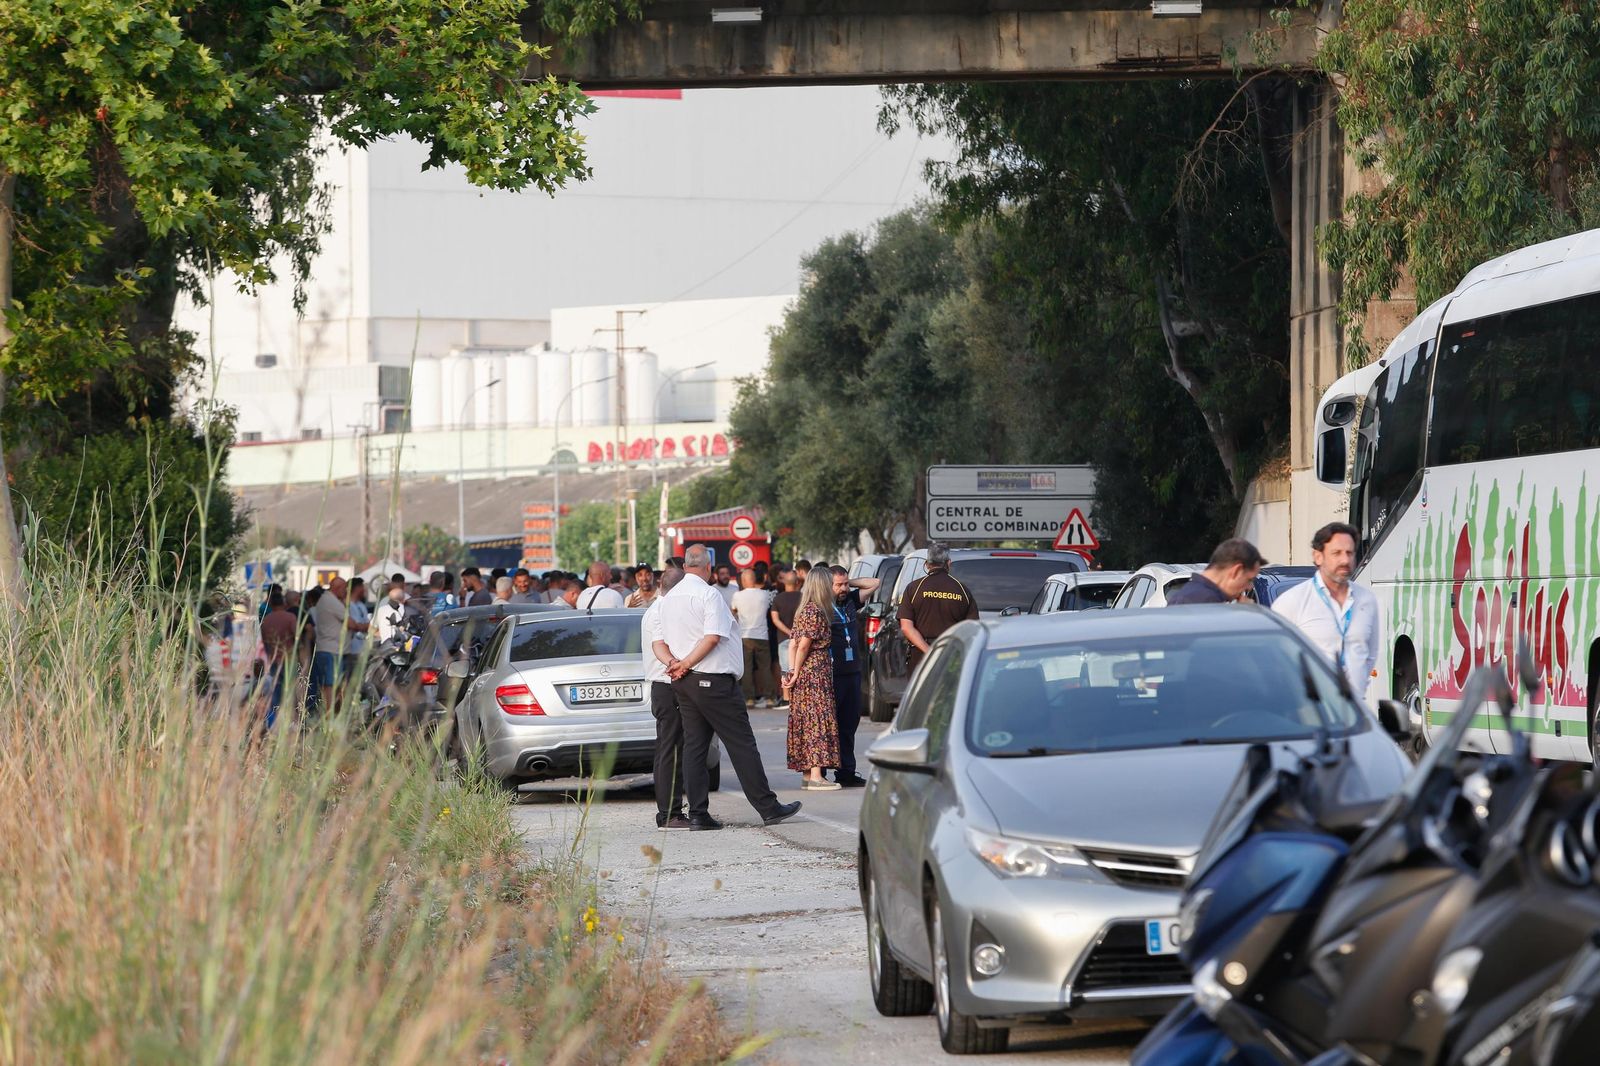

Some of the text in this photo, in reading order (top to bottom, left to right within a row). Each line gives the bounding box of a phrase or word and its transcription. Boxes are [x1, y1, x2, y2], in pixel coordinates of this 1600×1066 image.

[936, 506, 1023, 517] CENTRAL DE
[936, 521, 977, 532] CICLO
[736, 550, 749, 560] 30
[923, 591, 962, 601] PROSEGUR
[580, 685, 638, 699] 3923 KFY
